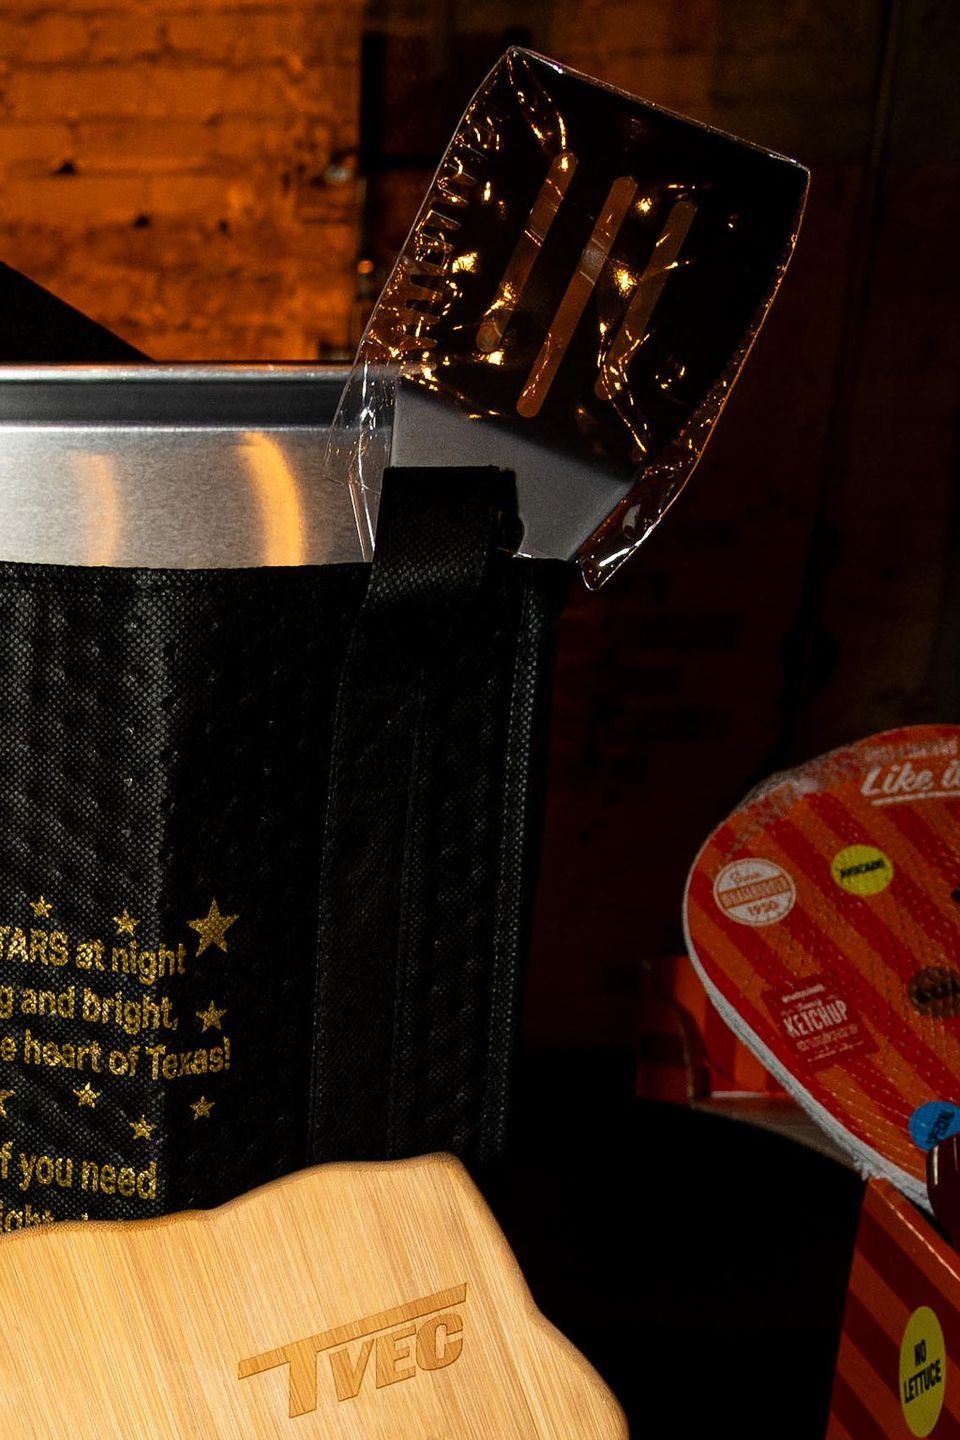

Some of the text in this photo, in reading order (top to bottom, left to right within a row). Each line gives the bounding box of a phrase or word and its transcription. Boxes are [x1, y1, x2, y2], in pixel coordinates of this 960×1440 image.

[861, 761, 935, 797] Like
[75, 939, 105, 972] at
[111, 939, 187, 986] night
[21, 986, 76, 1019] and
[82, 987, 179, 1036] bright,
[783, 999, 848, 1038] KETCHUP
[23, 1028, 102, 1073] heart
[108, 1044, 141, 1077] of
[145, 1036, 231, 1081] Texas!
[18, 1152, 74, 1192] you
[81, 1160, 158, 1201] need
[237, 1282, 468, 1419] TVEC
[913, 1338, 927, 1368] NO
[903, 1358, 942, 1404] LETTUCE
